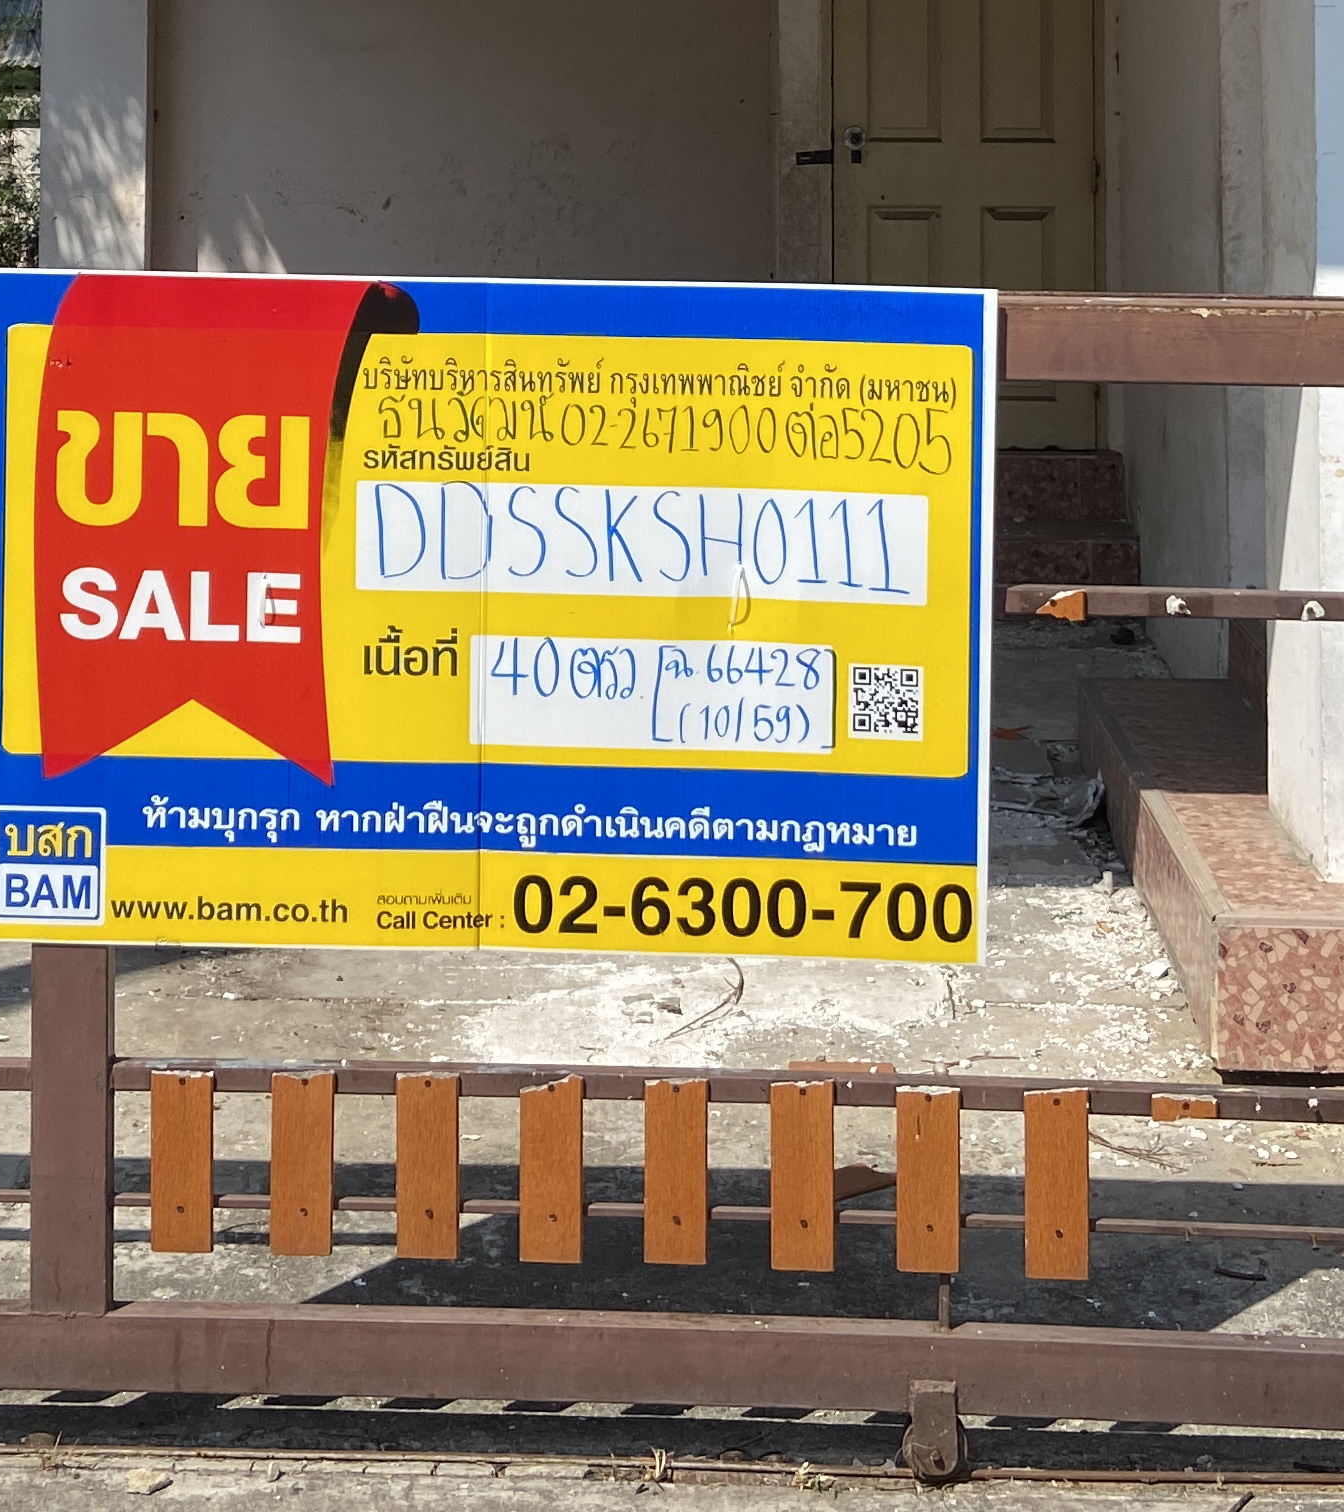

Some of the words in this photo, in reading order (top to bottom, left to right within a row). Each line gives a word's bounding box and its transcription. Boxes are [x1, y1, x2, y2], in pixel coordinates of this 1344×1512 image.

[363, 355, 605, 394] บริษัทบริหารสินทรัพย์
[610, 360, 786, 407] กรุงเทพพาณิชย์
[790, 362, 851, 399] จำกัด
[859, 374, 957, 411] (มหาชน)
[55, 409, 311, 530] ขาย
[362, 443, 531, 472] รหัสทรัพย์สิน
[59, 566, 302, 644] SALE
[362, 625, 458, 677] เนื้อที่
[4, 821, 93, 859] บสก
[141, 795, 301, 843] ห้ามบุกรุก
[315, 799, 918, 853] หากฝ่าฝืนจะถูกดำเนินคดีตามกฎหมาย
[5, 872, 92, 910] BAM
[110, 896, 349, 924] www.bam.co.th
[512, 874, 973, 943] 02-6300-700
[376, 910, 416, 930] Call
